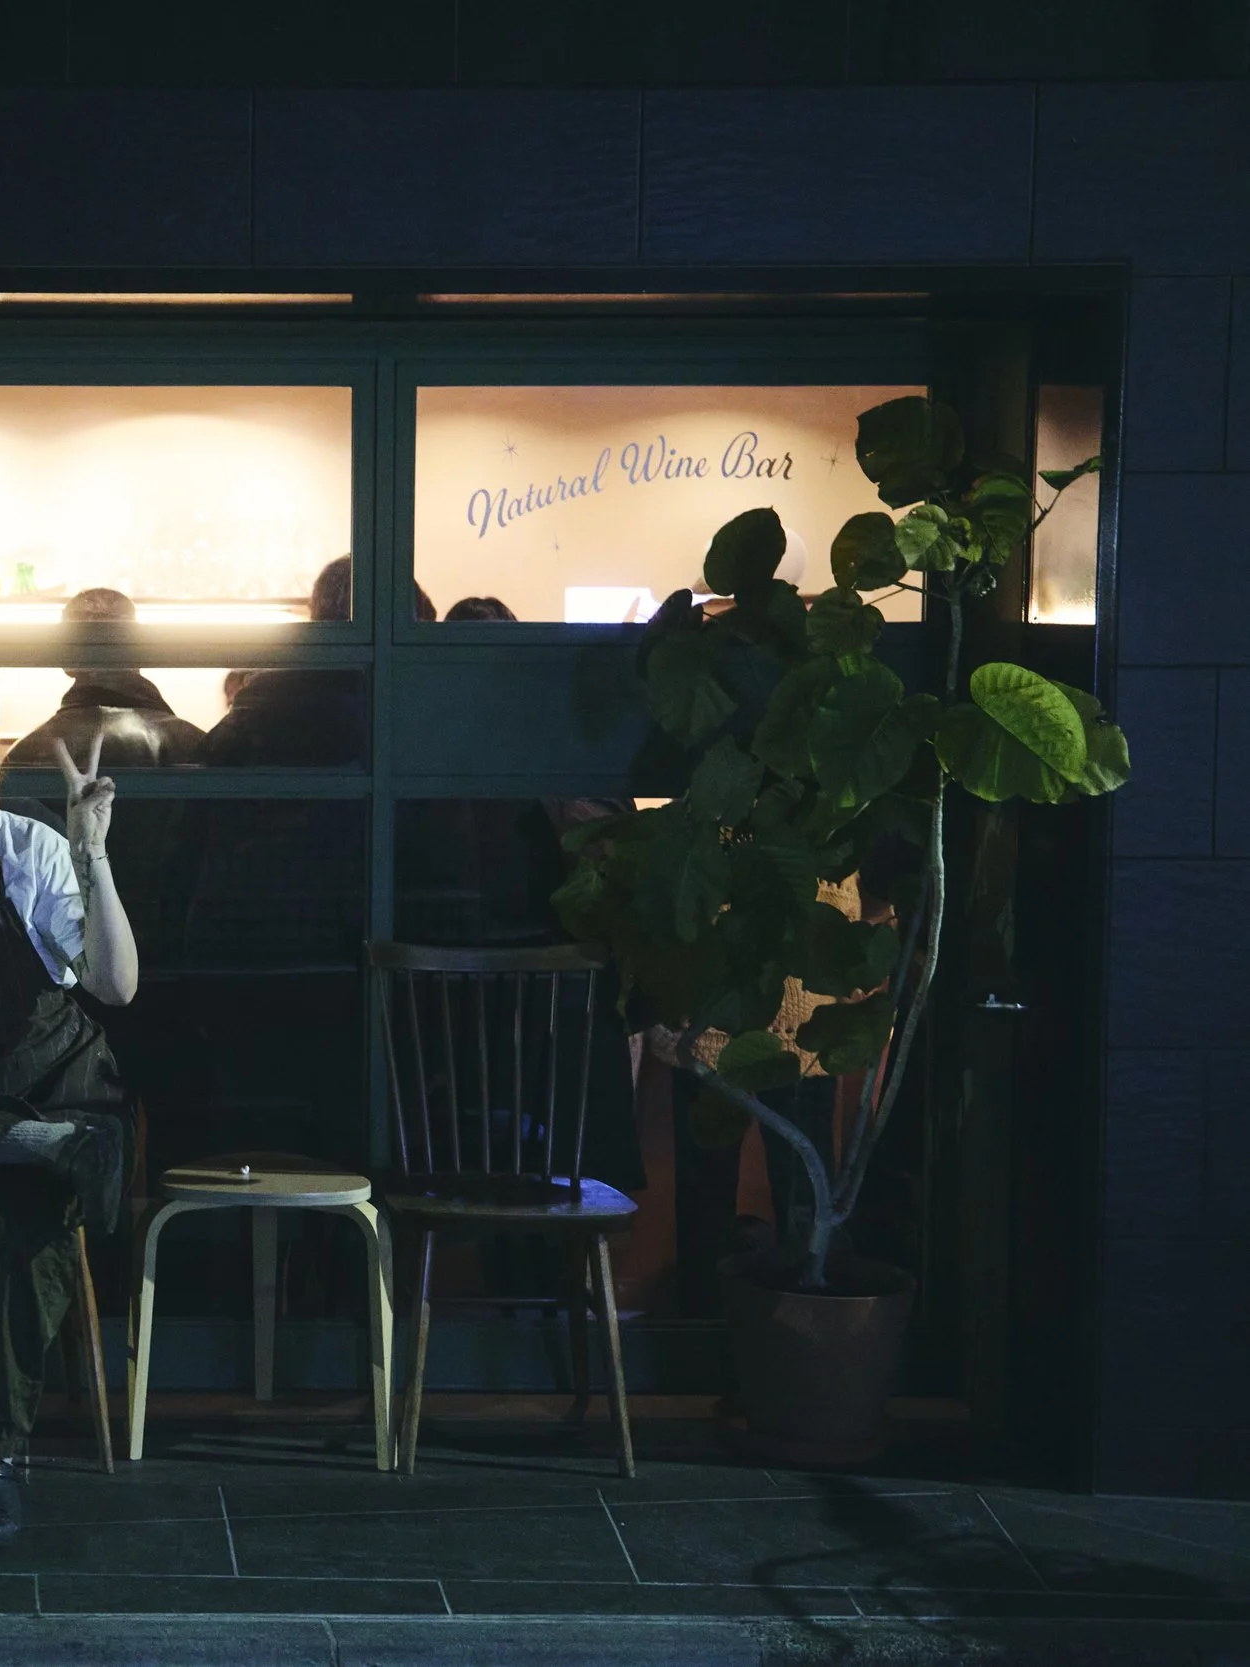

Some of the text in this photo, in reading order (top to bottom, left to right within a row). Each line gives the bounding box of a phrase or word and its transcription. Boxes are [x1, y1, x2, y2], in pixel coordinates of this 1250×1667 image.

[467, 431, 794, 540] Natural Wine Bar
